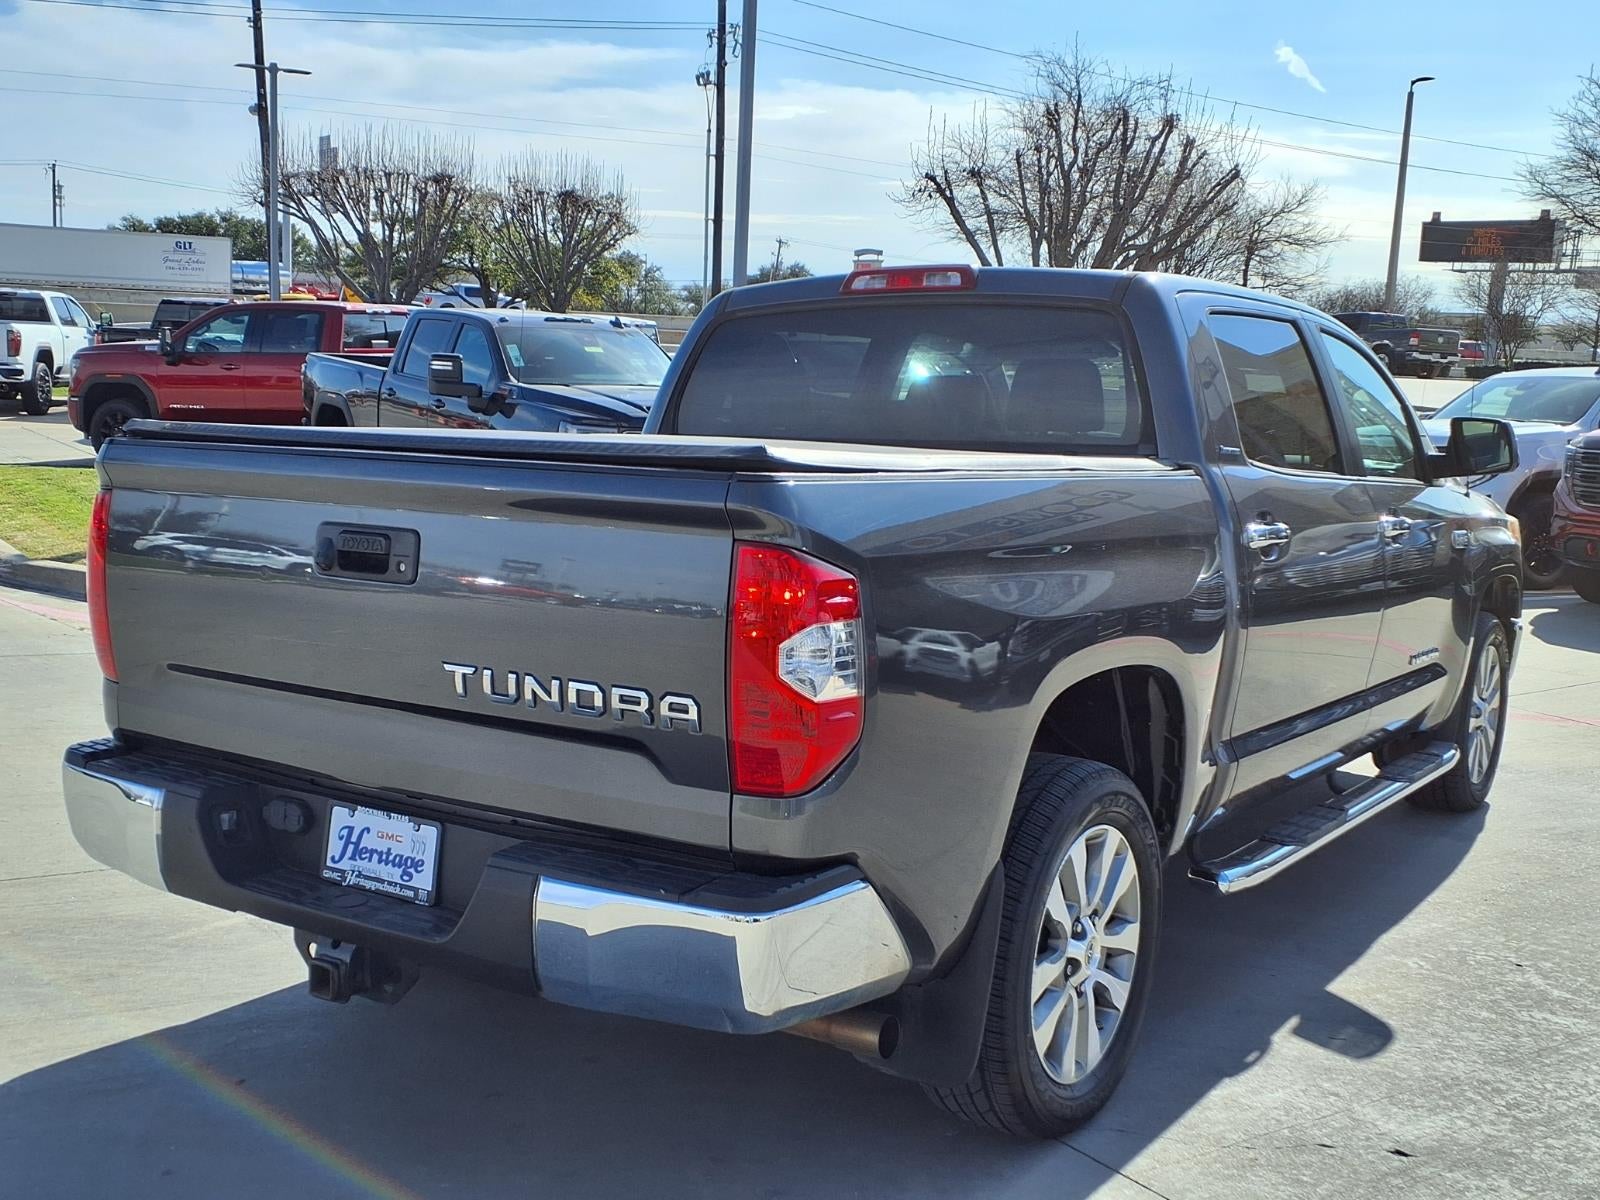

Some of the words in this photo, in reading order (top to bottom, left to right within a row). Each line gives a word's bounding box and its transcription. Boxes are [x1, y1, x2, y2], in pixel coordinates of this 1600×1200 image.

[175, 240, 194, 250] GLT
[341, 536, 384, 552] TOYOTA
[441, 660, 703, 736] TUNDRA
[391, 812, 410, 823] TEXAS
[376, 830, 404, 844] GMC
[331, 825, 425, 882] Heritage
[322, 870, 342, 880] GMC
